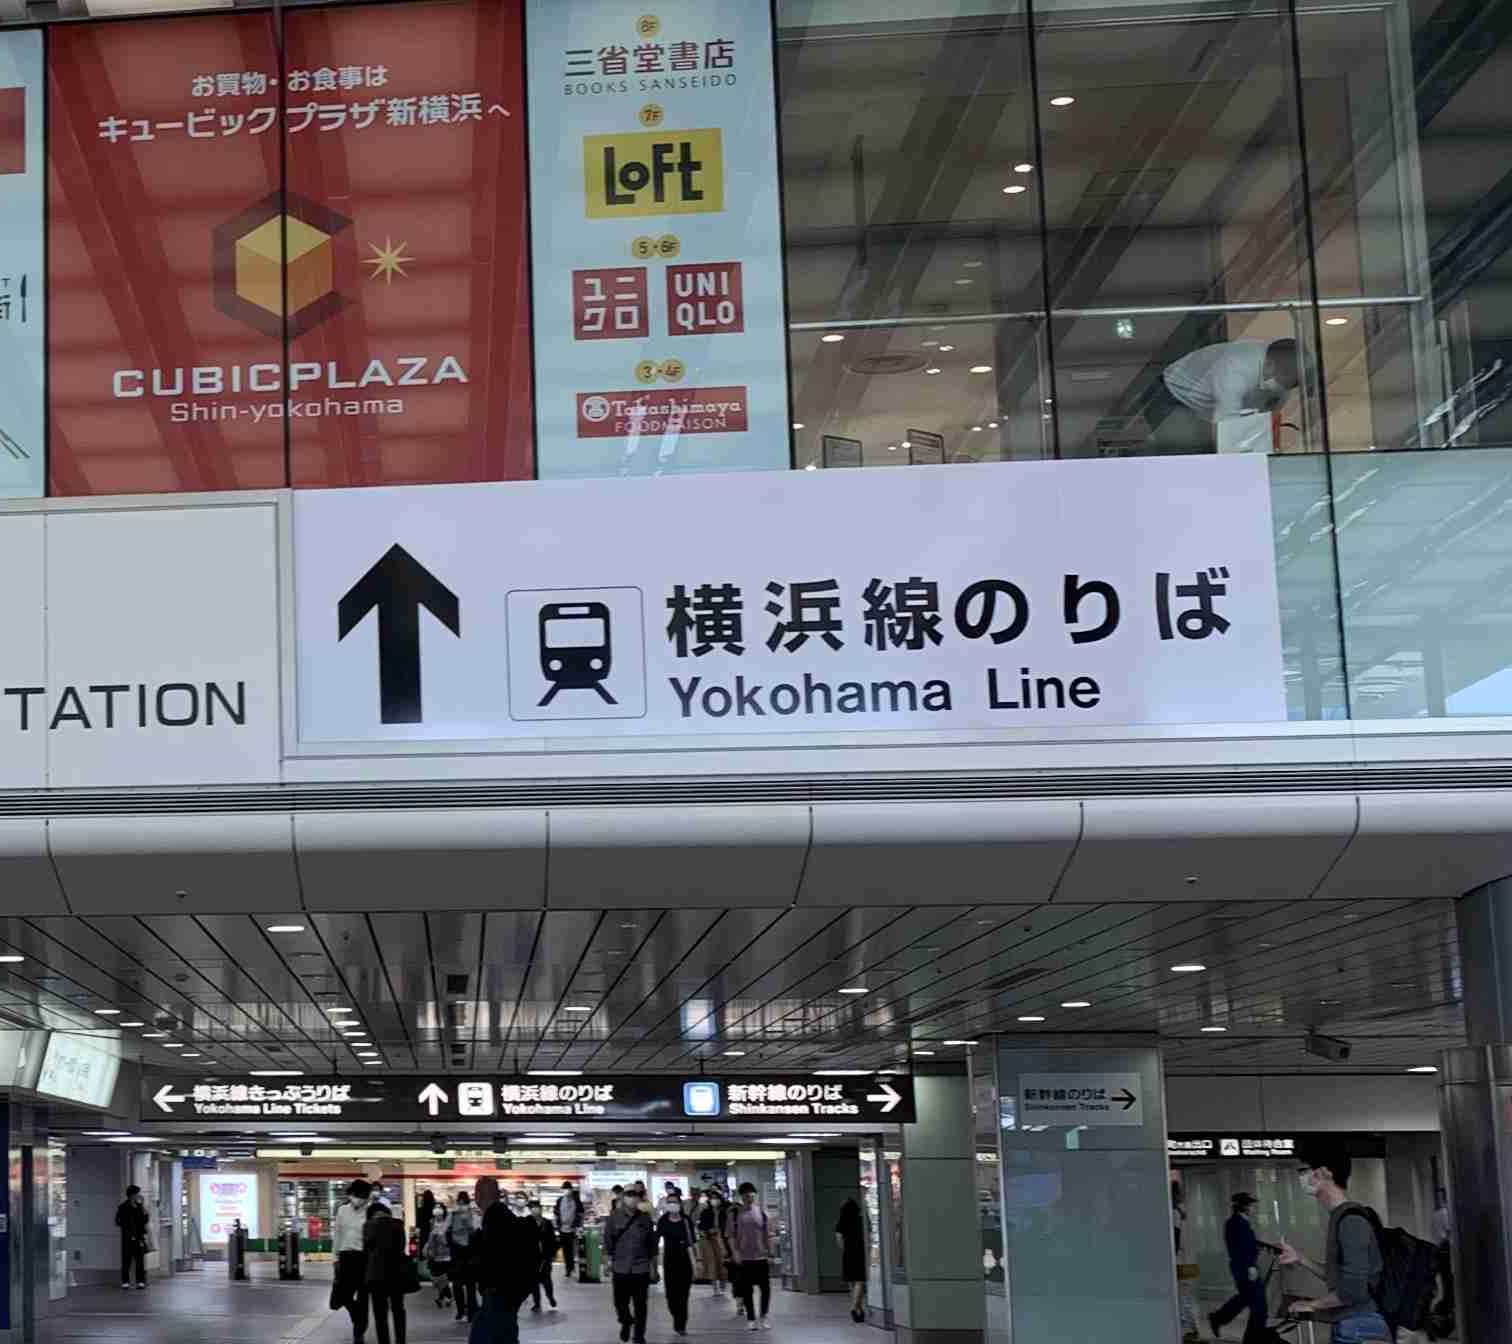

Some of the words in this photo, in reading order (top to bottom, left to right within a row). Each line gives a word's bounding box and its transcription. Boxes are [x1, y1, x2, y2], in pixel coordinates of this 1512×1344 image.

[565, 38, 735, 77] 三省堂書店
[191, 65, 388, 97] お買物・お食事は
[564, 80, 628, 96] BOOKS
[639, 73, 737, 92] SANSEIDO
[643, 109, 661, 122] 7F
[583, 275, 638, 301] ユニ
[674, 271, 729, 297] UNI
[582, 306, 639, 332] クロ
[676, 301, 735, 330] QLO
[171, 398, 403, 423] Shin-yokohama
[611, 395, 742, 417] Takashimaya
[665, 567, 1232, 659] 横浜線のりば
[668, 674, 952, 718] Yokohama
[986, 666, 1102, 710] Line
[728, 1084, 843, 1102] 新幹線のりば
[194, 1103, 261, 1114] Yokohama
[262, 1102, 292, 1114] Line
[293, 1102, 341, 1114] Tickets
[502, 1103, 572, 1114] Yokohama
[574, 1102, 605, 1114] Line
[729, 1103, 809, 1114] Shinkansen
[810, 1102, 859, 1114] Tracks
